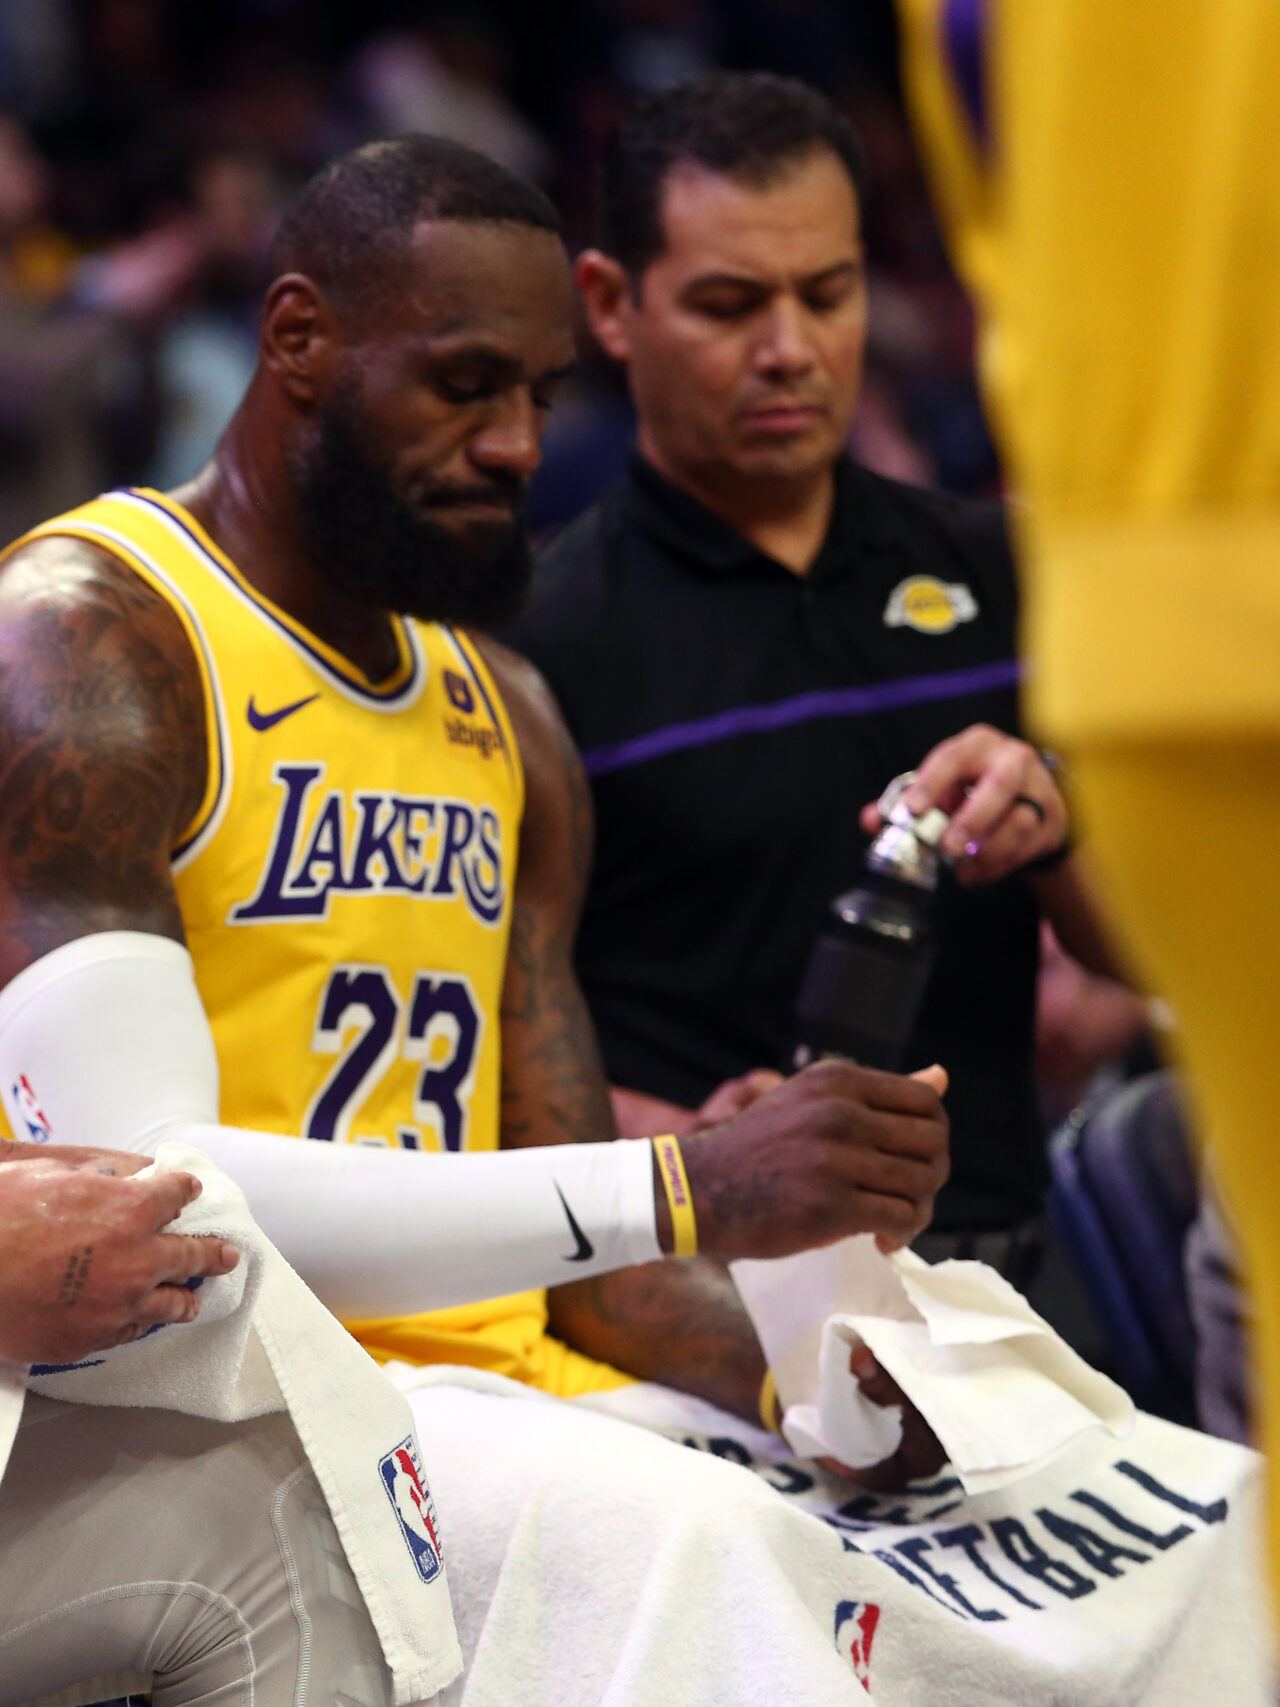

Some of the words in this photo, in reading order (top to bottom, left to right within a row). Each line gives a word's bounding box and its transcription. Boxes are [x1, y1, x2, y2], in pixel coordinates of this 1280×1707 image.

[225, 760, 505, 929] LAKERS
[304, 962, 485, 1153] 23
[870, 1460, 1229, 1621] ETBALL
